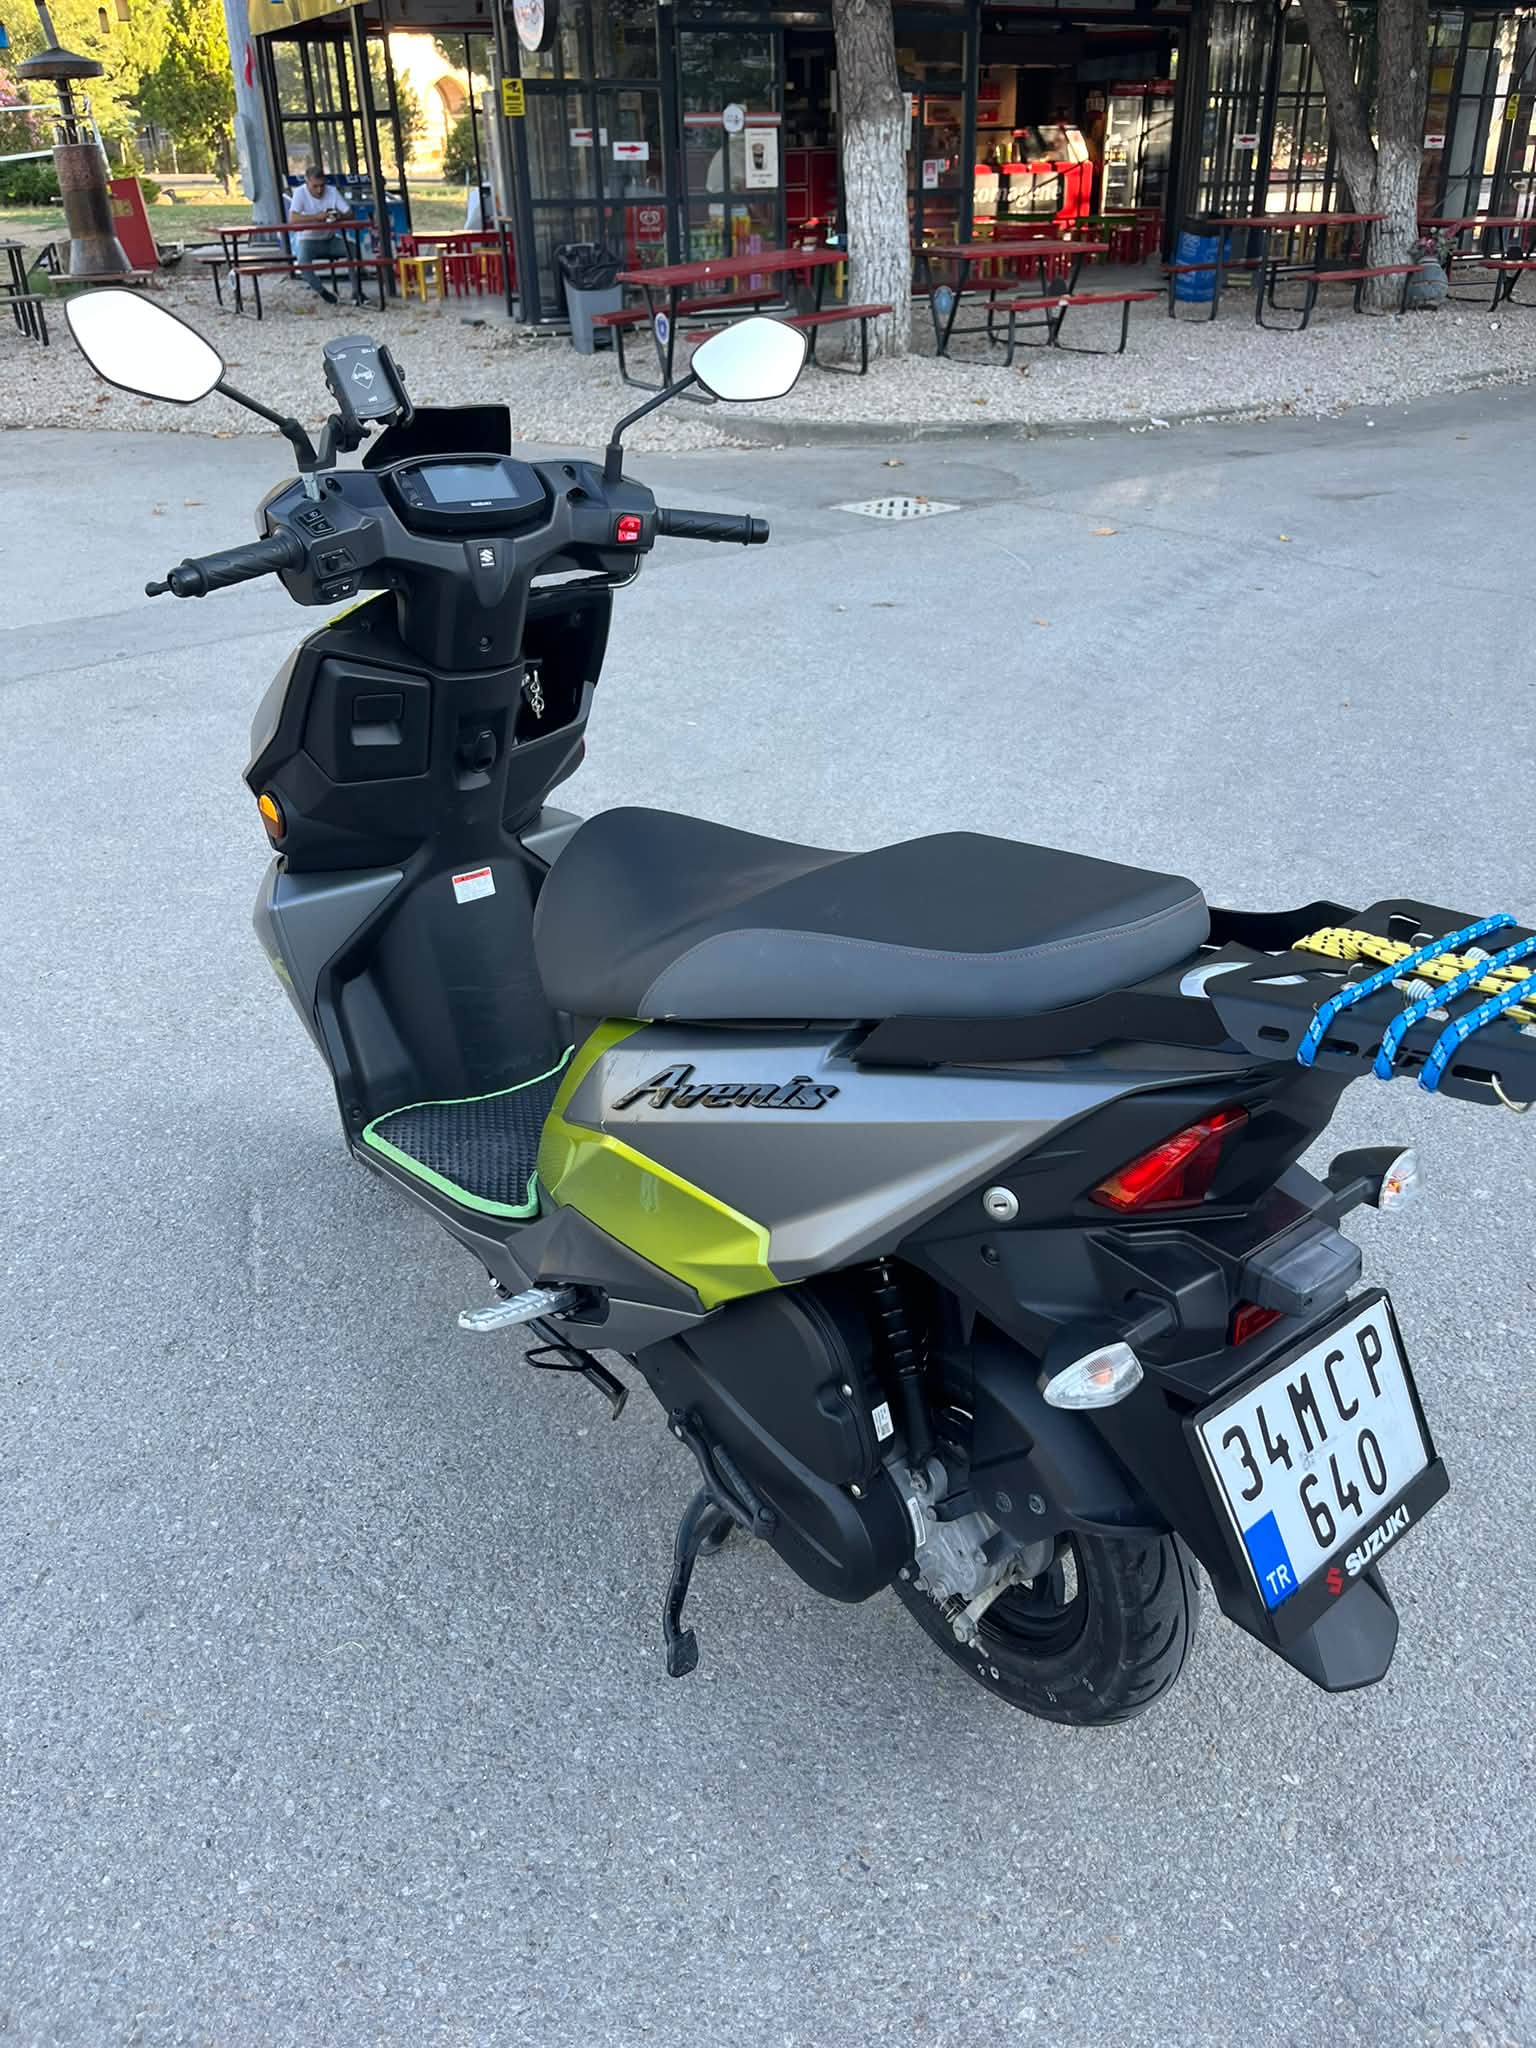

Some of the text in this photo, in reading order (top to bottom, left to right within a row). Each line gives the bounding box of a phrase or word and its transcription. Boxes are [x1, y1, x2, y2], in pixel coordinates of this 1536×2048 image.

[611, 1063, 840, 1110] Avenis
[1299, 1428, 1388, 1549] 640
[1344, 1504, 1410, 1577] SUZUKI
[1265, 1563, 1291, 1596] TR
